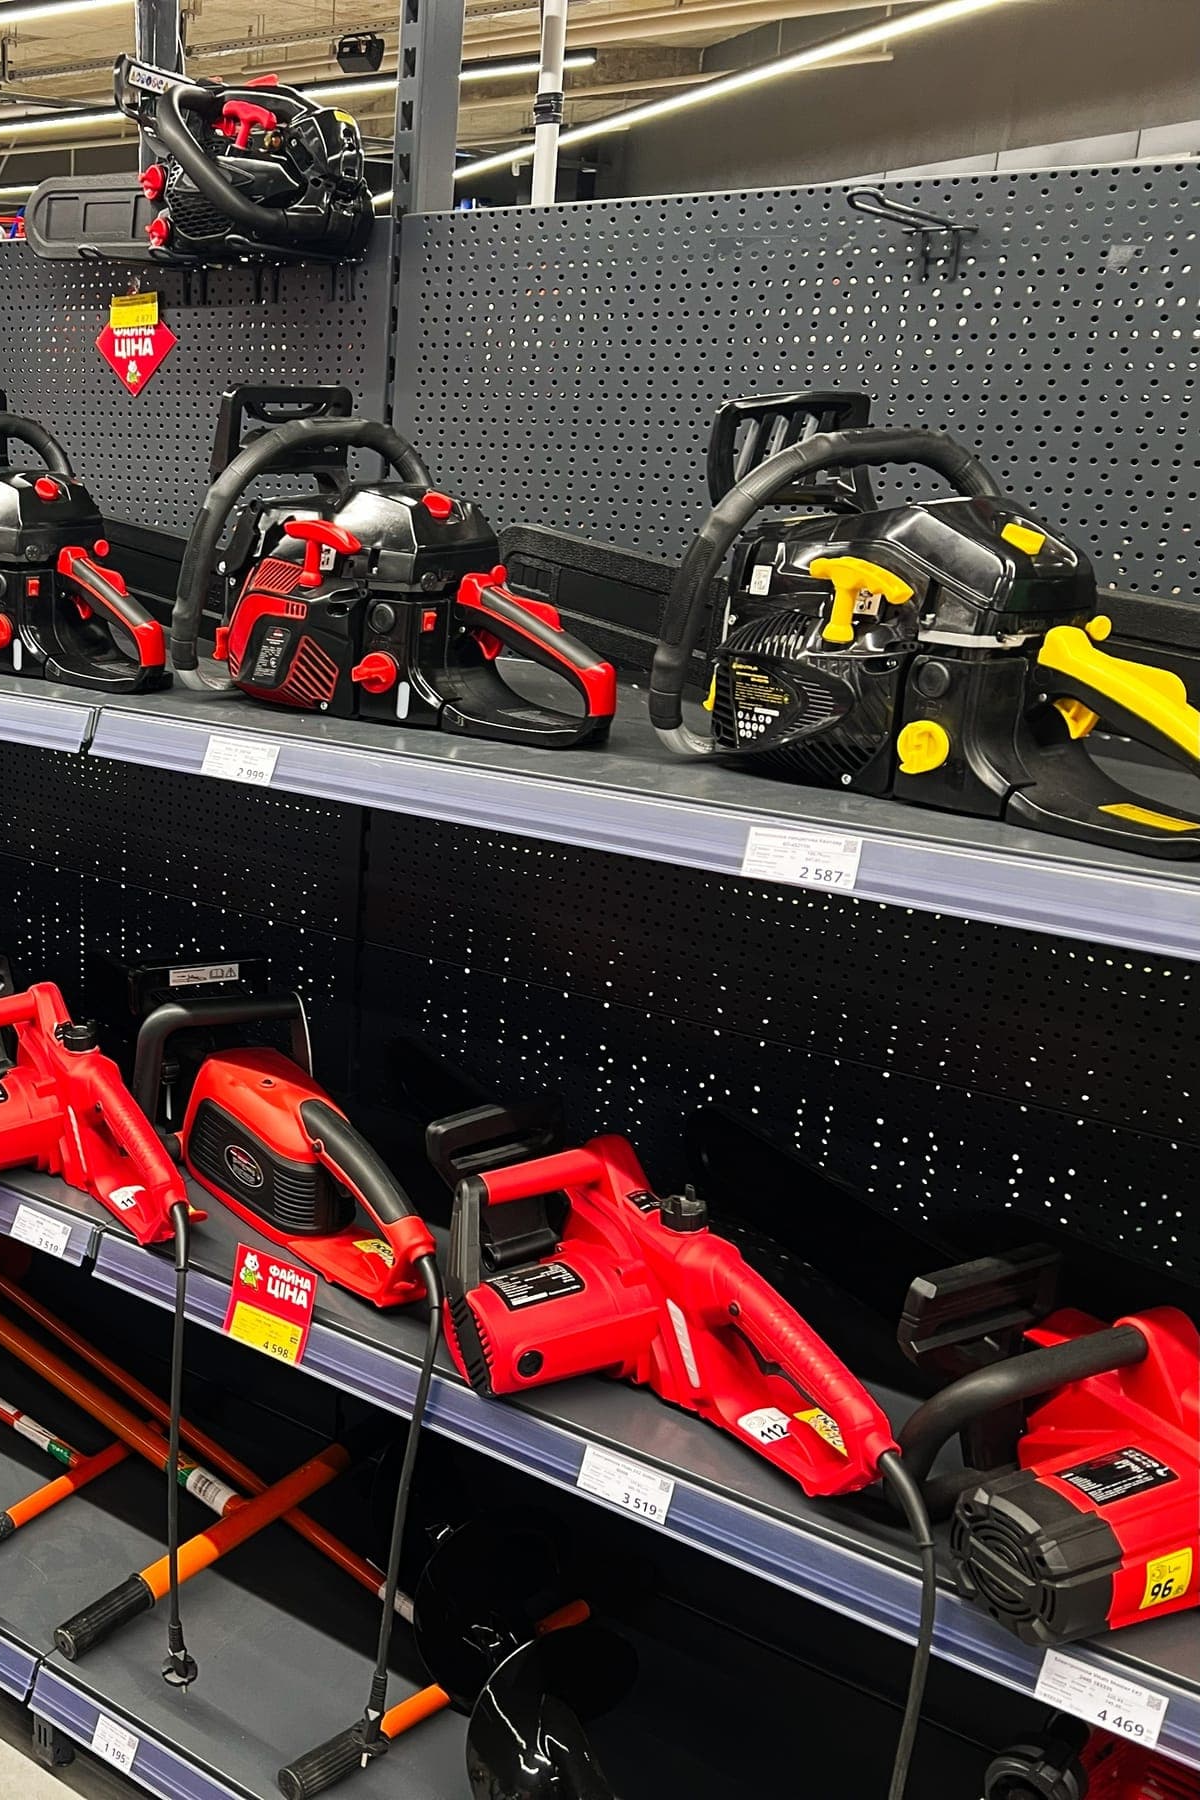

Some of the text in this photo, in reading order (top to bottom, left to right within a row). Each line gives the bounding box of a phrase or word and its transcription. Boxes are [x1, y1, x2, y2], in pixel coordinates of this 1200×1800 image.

[114, 338, 154, 359] ЦІНА
[236, 767, 264, 779] 2 999
[799, 866, 844, 884] 2 587
[37, 1237, 59, 1252] 3 519
[269, 1265, 312, 1292] ФАЙНА
[266, 1276, 308, 1309] ЦІНА
[263, 1341, 288, 1358] 4 598
[760, 1423, 789, 1440] 112
[622, 1492, 657, 1515] 3 519
[1150, 1578, 1175, 1602] 96
[1097, 1710, 1145, 1737] 4 469
[111, 1747, 126, 1763] 195
